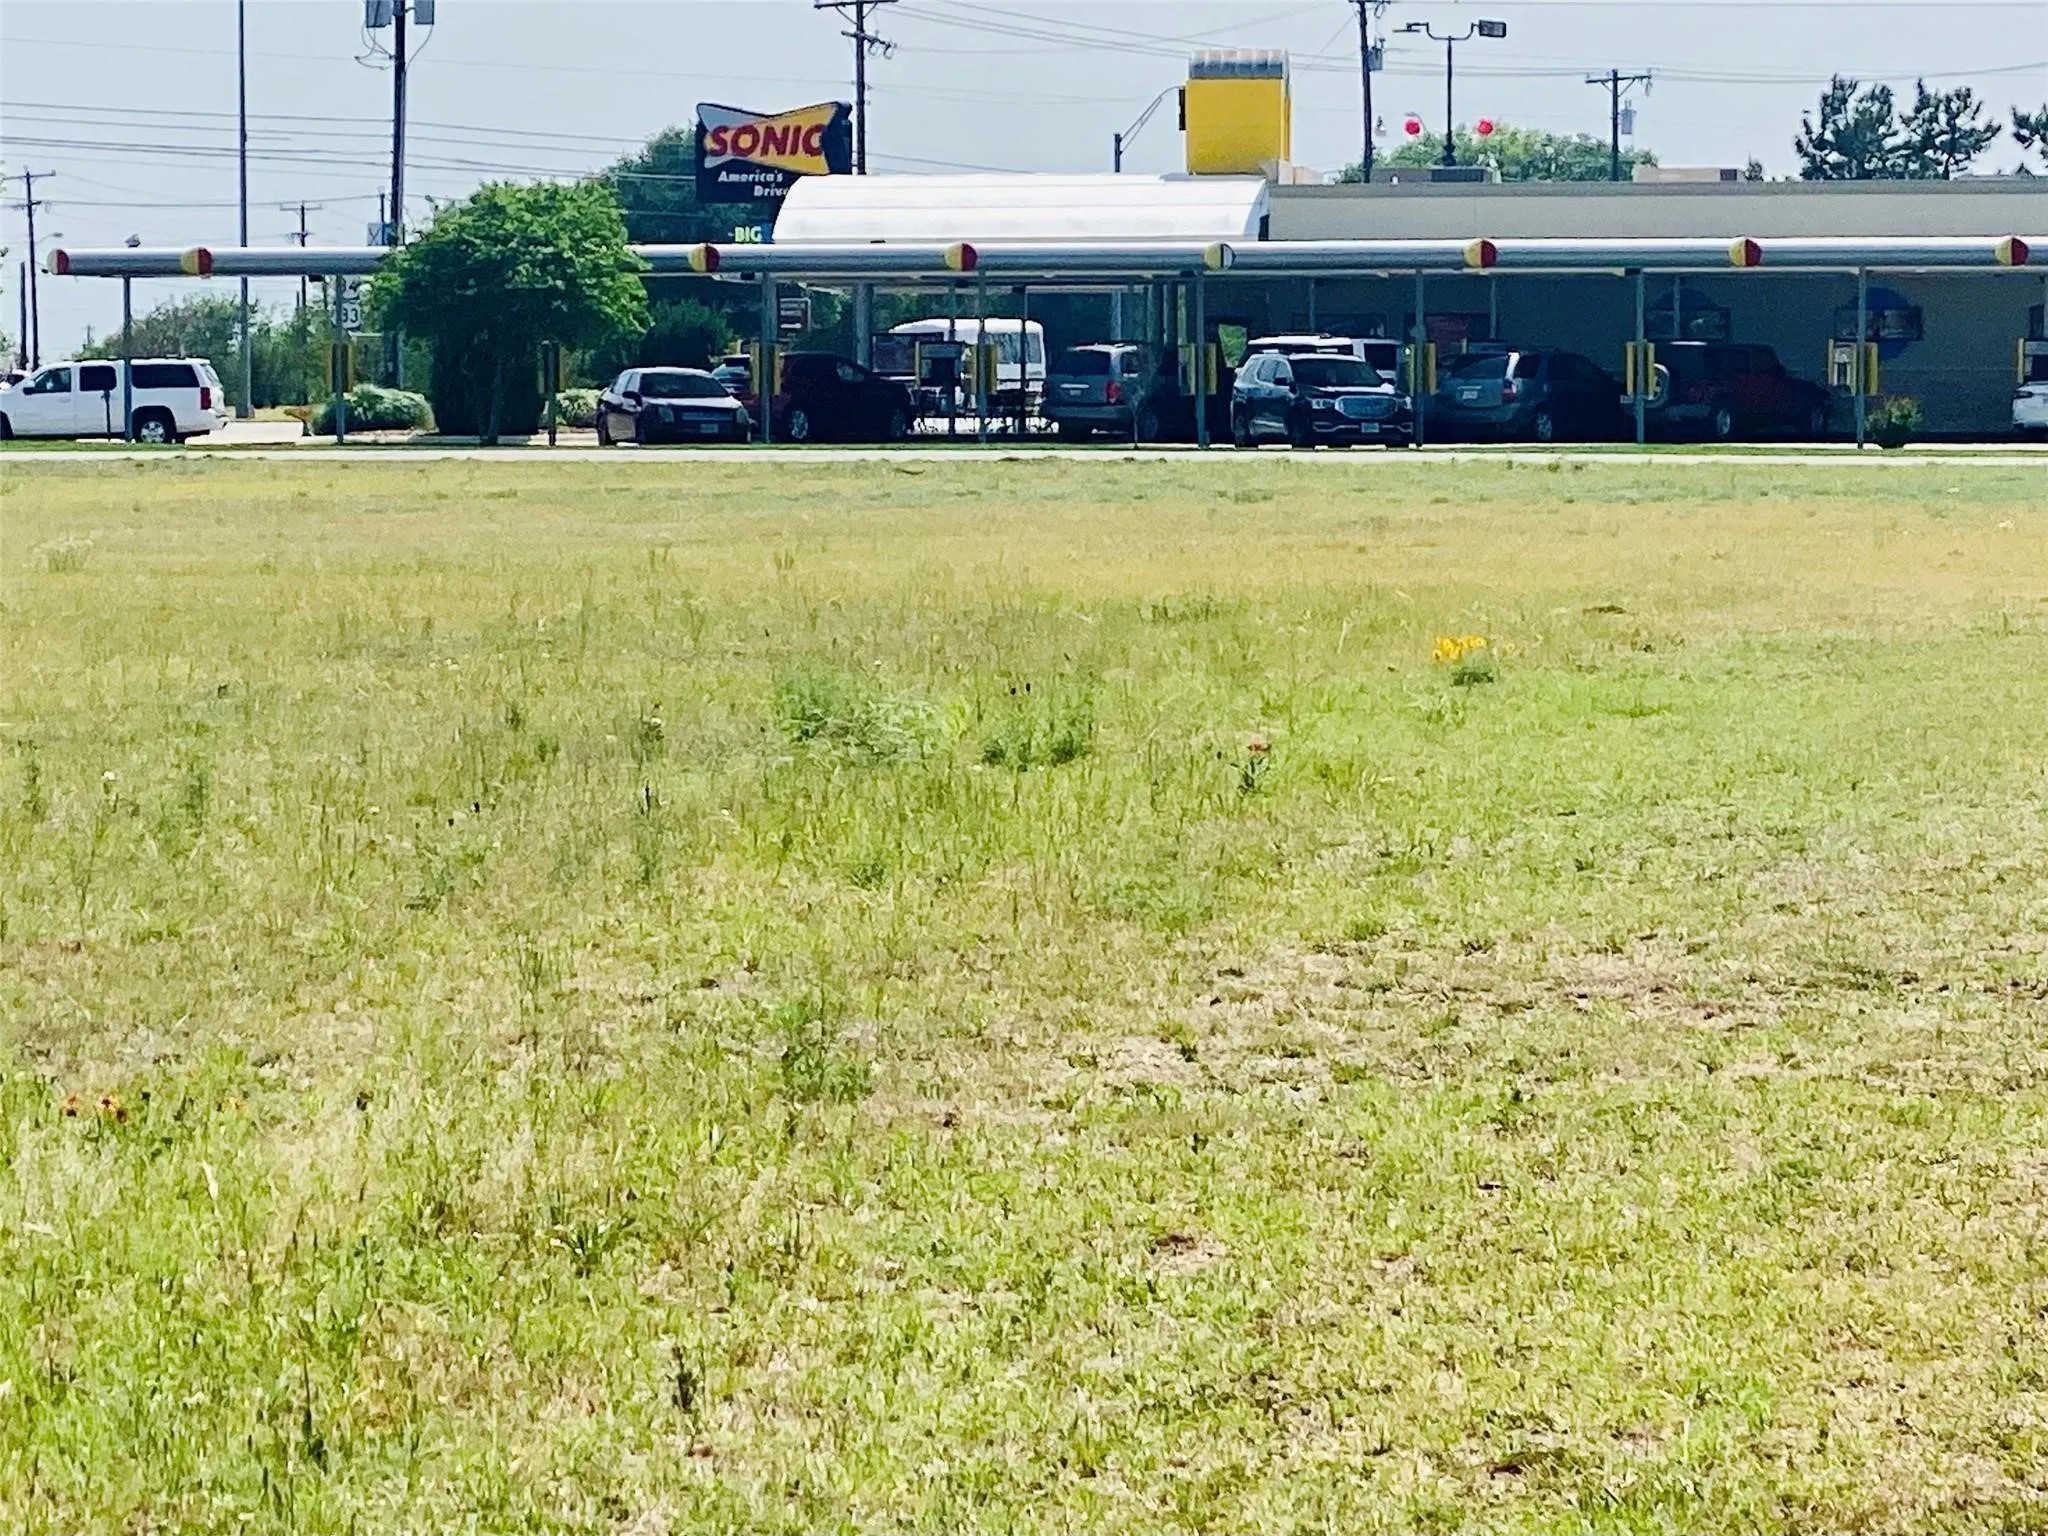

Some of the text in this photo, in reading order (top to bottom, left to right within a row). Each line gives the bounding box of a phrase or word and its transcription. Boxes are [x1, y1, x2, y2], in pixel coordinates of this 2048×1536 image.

[710, 123, 826, 157] SONIC
[717, 169, 783, 183] America's
[734, 226, 762, 242] BIG
